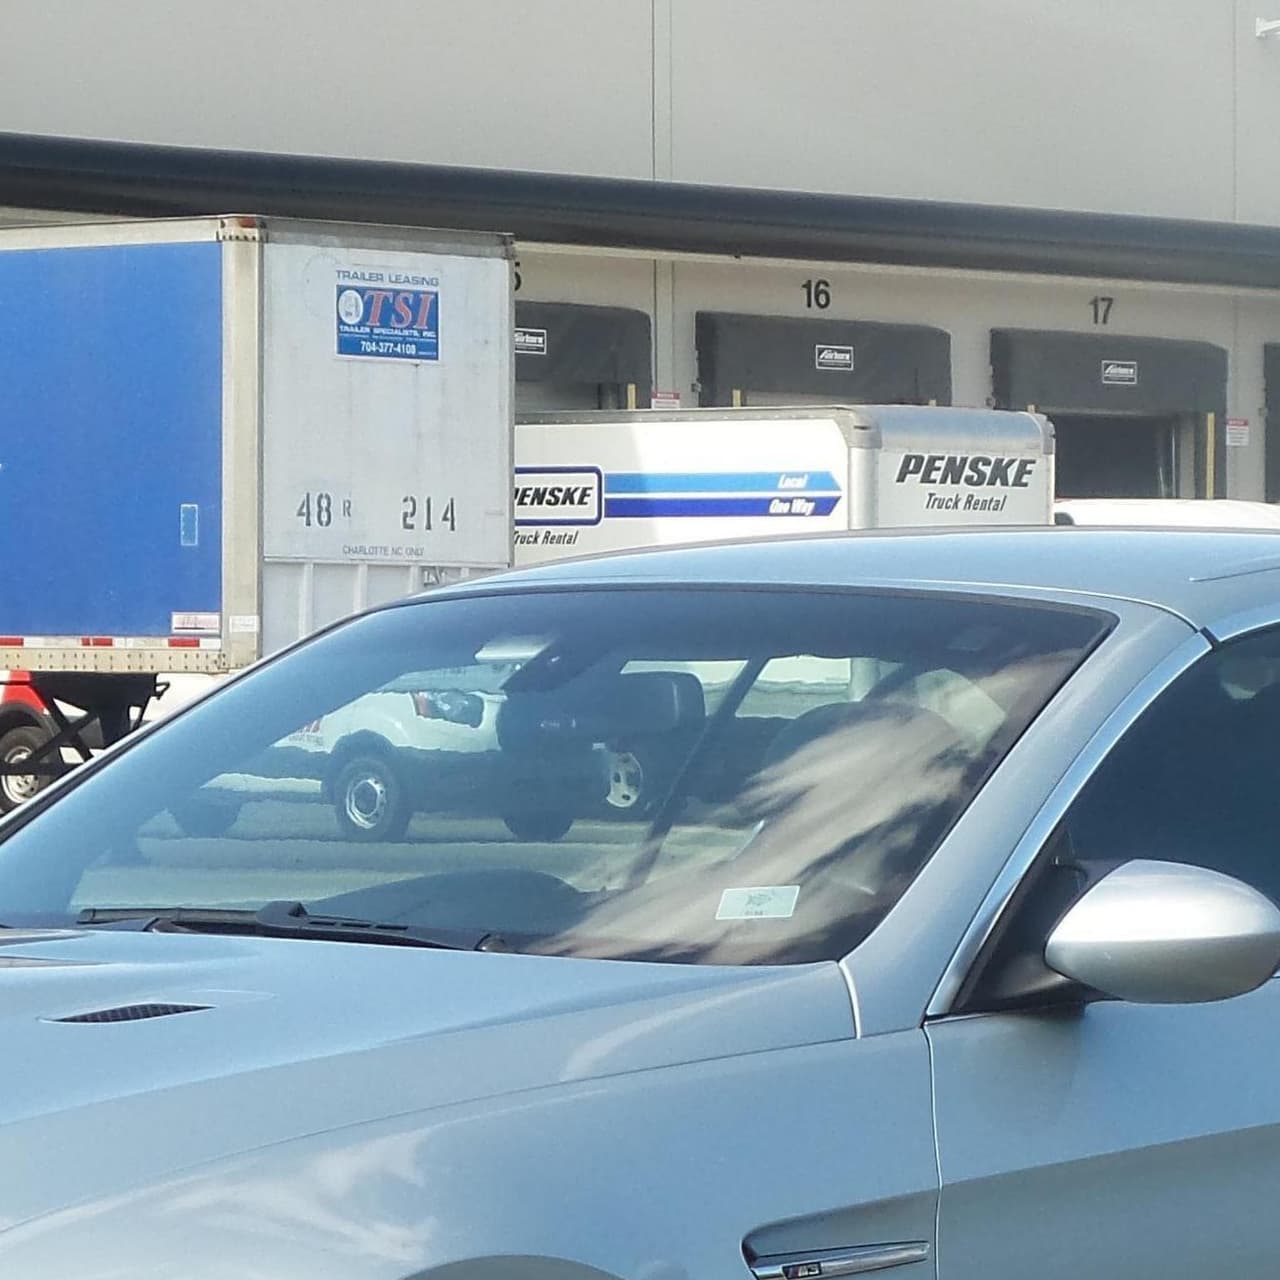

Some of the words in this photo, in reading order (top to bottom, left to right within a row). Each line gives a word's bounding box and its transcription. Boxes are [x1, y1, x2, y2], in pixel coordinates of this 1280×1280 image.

[336, 269, 384, 282] TRAILER
[389, 273, 439, 287] LEASING
[801, 279, 830, 309] 16
[363, 289, 436, 330] TSI
[1089, 296, 1114, 325] 17
[777, 473, 809, 489] Local
[896, 453, 1036, 488] PENSKE
[296, 492, 332, 527] 48
[402, 496, 456, 532] 214
[769, 499, 790, 514] One
[790, 498, 815, 516] Way
[924, 492, 960, 511] Truck
[962, 494, 1008, 512] Rental
[541, 530, 579, 544] Rental
